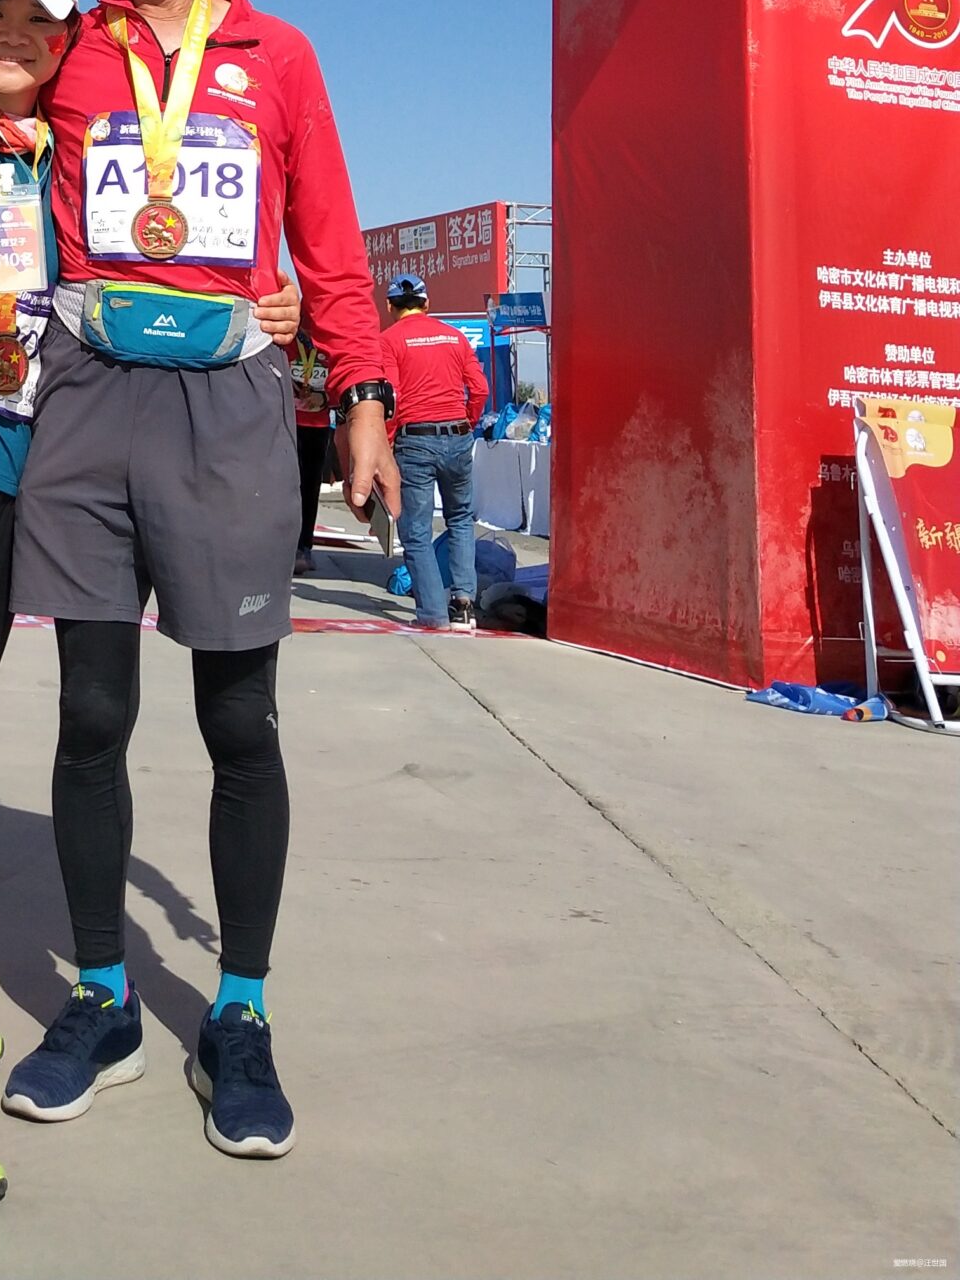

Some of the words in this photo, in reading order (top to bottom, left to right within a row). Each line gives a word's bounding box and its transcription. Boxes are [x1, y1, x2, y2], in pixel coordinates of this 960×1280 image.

[448, 208, 493, 251] 签名墙
[452, 253, 479, 269] Signature
[882, 248, 933, 270] 主办单位
[885, 343, 935, 365] 赞助单位
[818, 463, 859, 482] 乌鲁木
